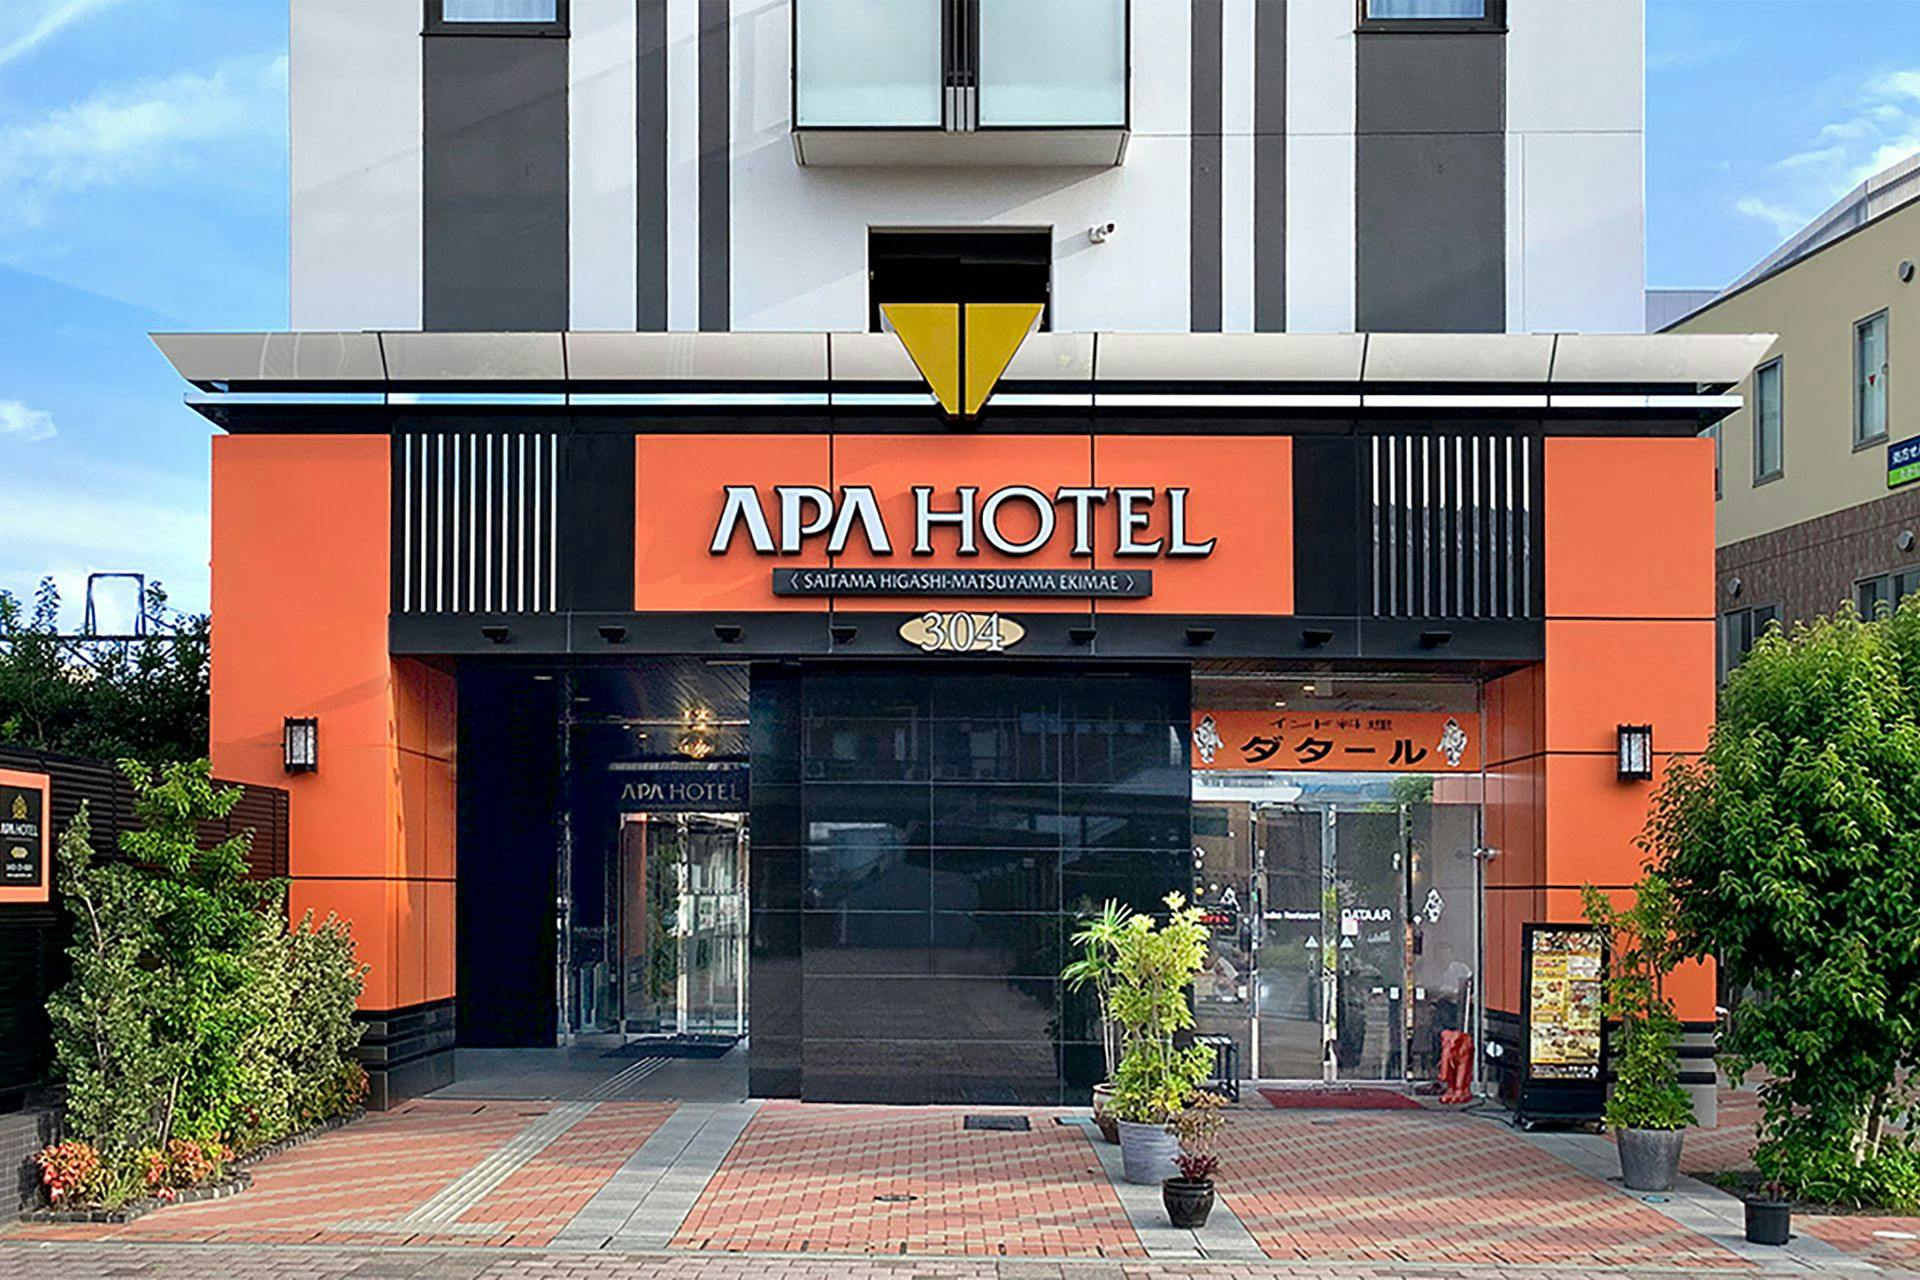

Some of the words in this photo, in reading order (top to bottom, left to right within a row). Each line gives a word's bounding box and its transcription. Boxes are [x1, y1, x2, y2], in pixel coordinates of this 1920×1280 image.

[710, 485, 894, 555] APA
[911, 485, 1217, 557] HOTEL
[804, 573, 876, 590] SAITAMA
[880, 573, 1056, 590] HIGASHI-MATSUYAMA
[1059, 574, 1119, 590] EKIMAE
[919, 611, 1006, 653] 304
[1240, 735, 1429, 765] ダタール
[621, 783, 664, 800] APA
[669, 784, 742, 801] HOTEL
